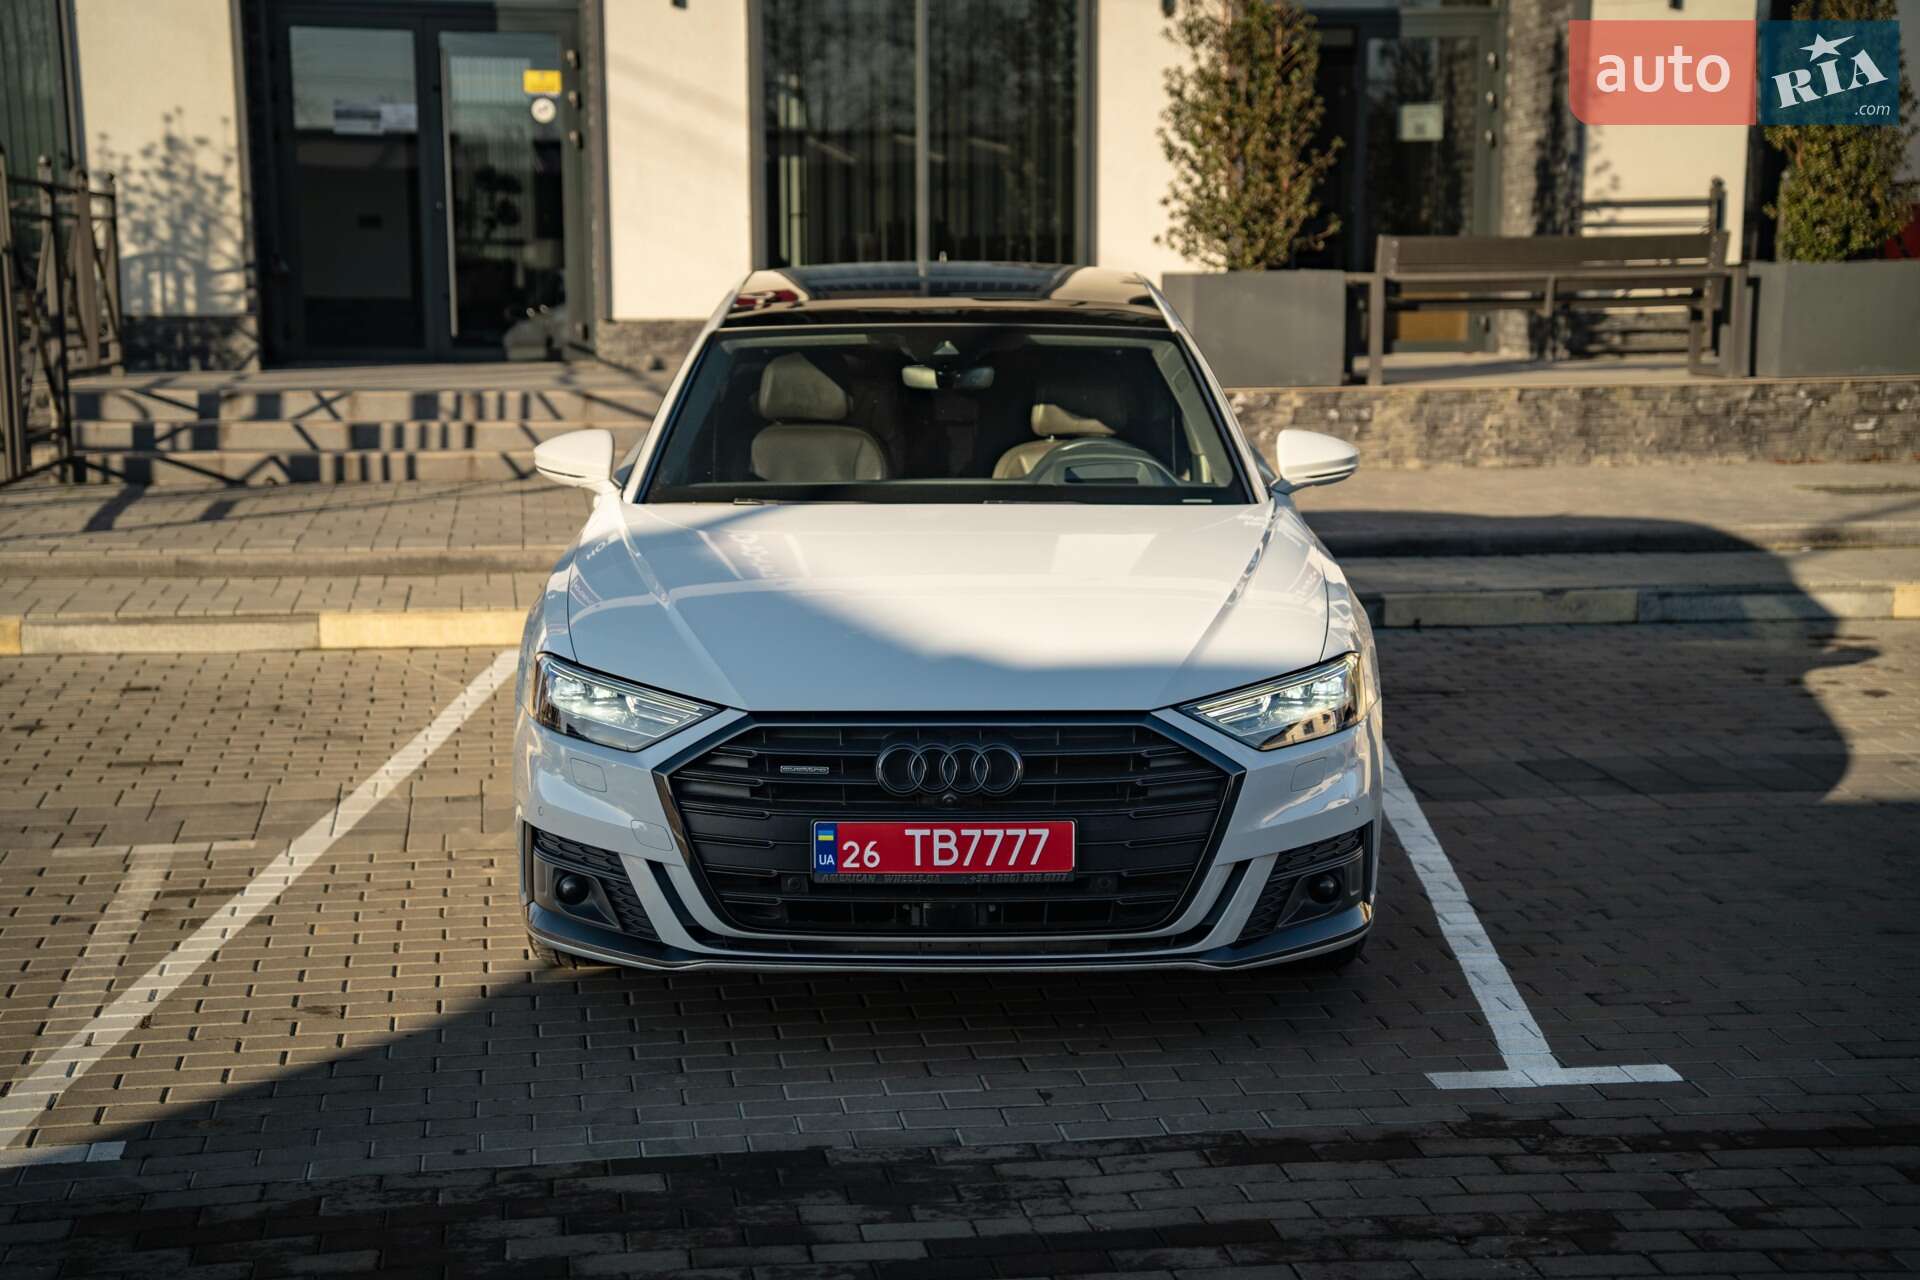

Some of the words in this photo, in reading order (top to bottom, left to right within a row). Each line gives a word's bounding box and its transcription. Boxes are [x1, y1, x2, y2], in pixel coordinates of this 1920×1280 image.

[818, 854, 835, 866] UA
[842, 840, 881, 868] 26
[904, 828, 1050, 867] TB7777
